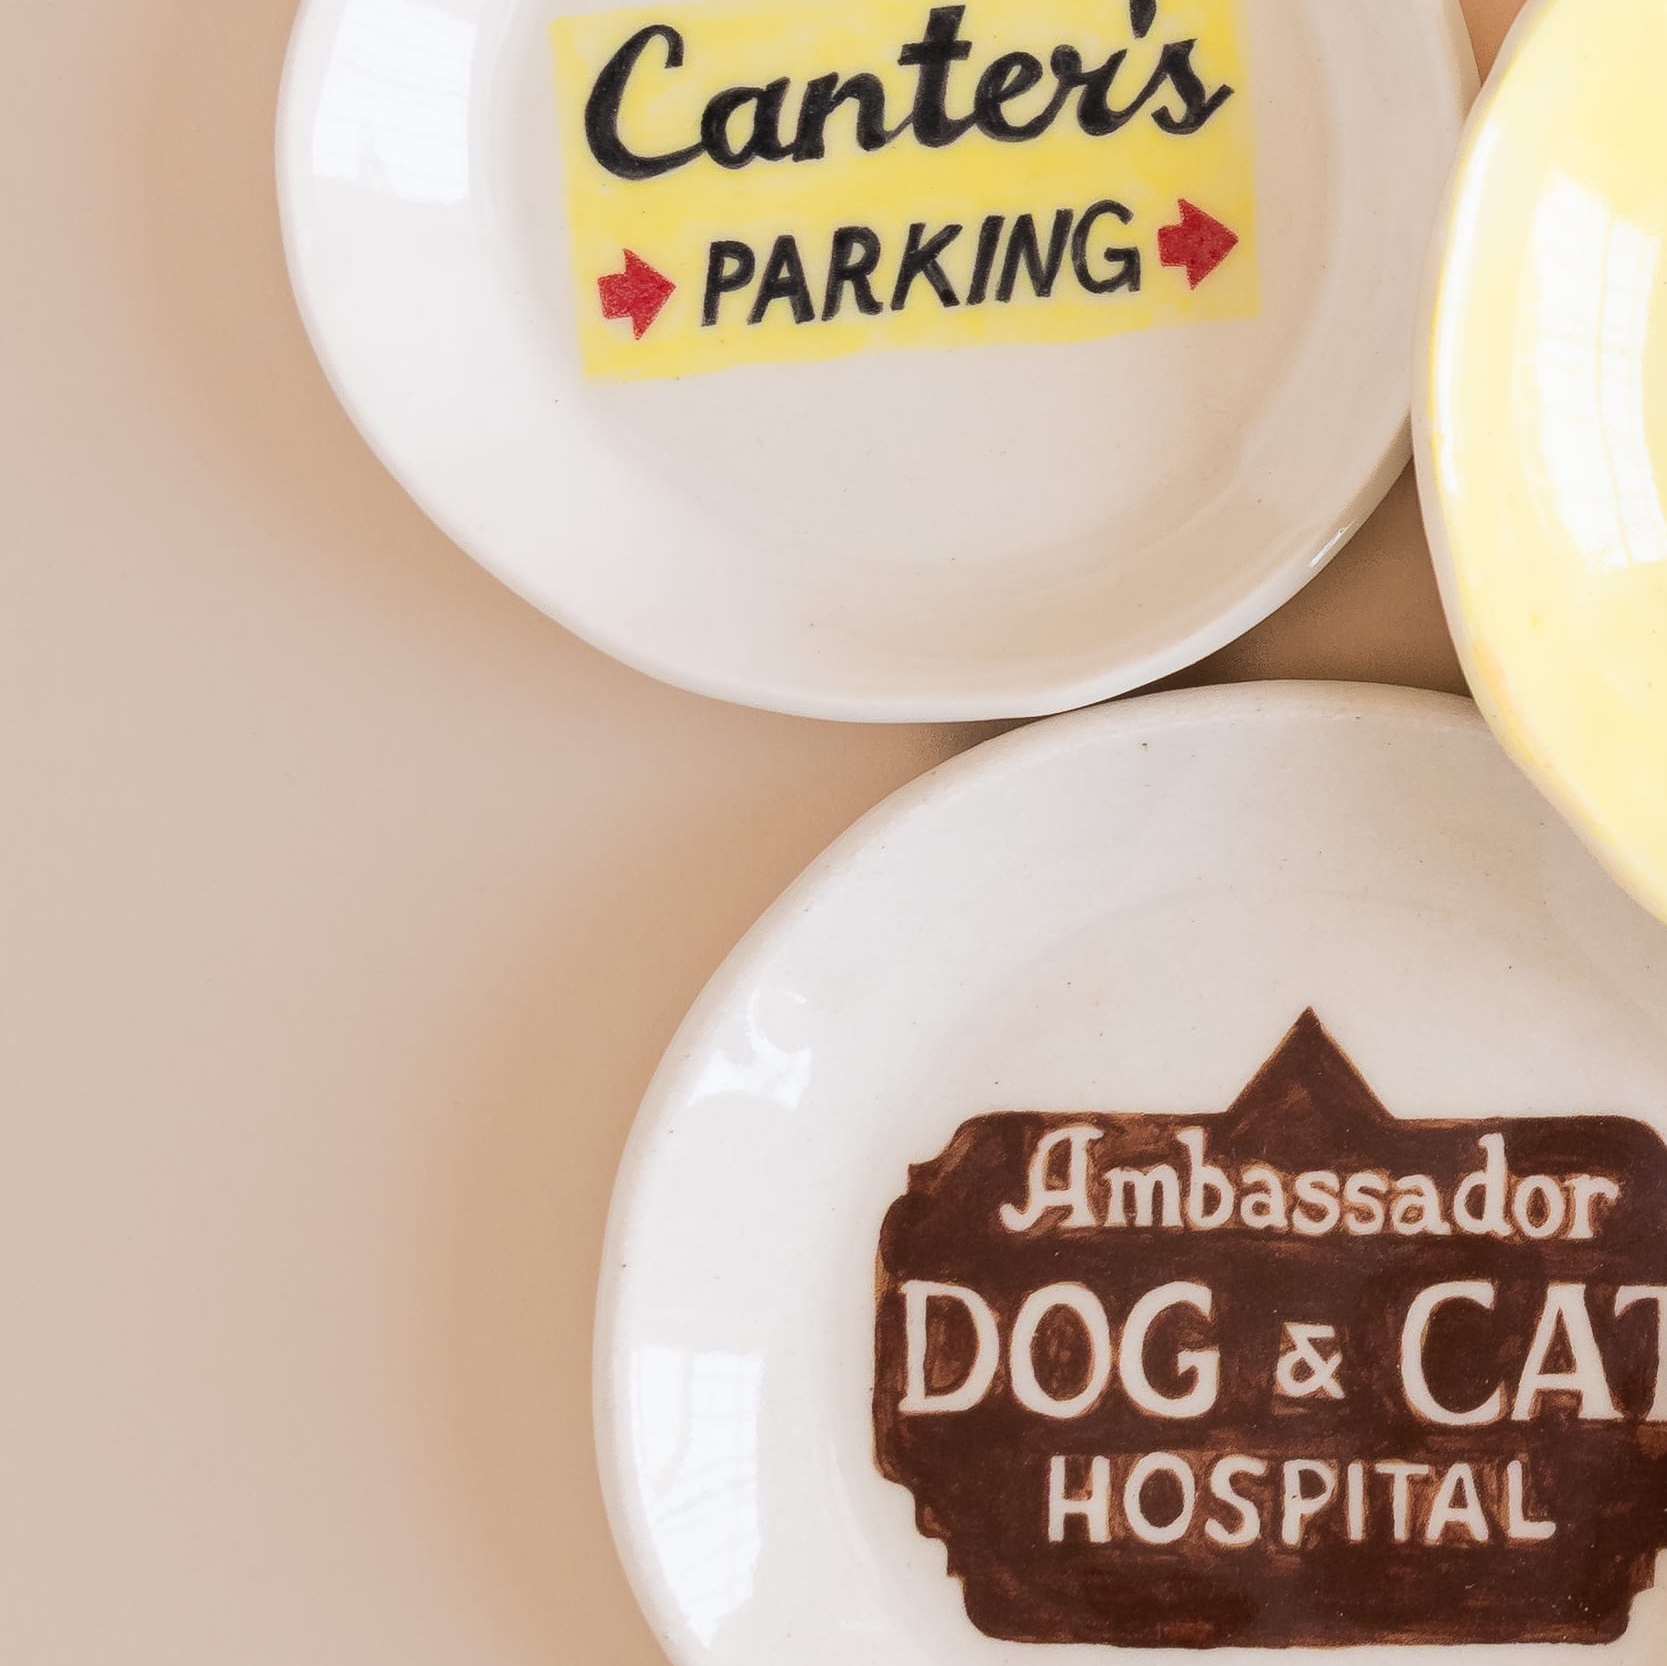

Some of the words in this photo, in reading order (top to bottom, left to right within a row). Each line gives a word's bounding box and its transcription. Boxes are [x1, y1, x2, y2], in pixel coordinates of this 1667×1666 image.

[700, 199, 1141, 327] PARKING
[1000, 1127, 1618, 1240] Ambassador
[897, 1280, 1219, 1420] DOG
[1275, 1322, 1346, 1401] &
[1048, 1451, 1557, 1547] HOSPITAL
